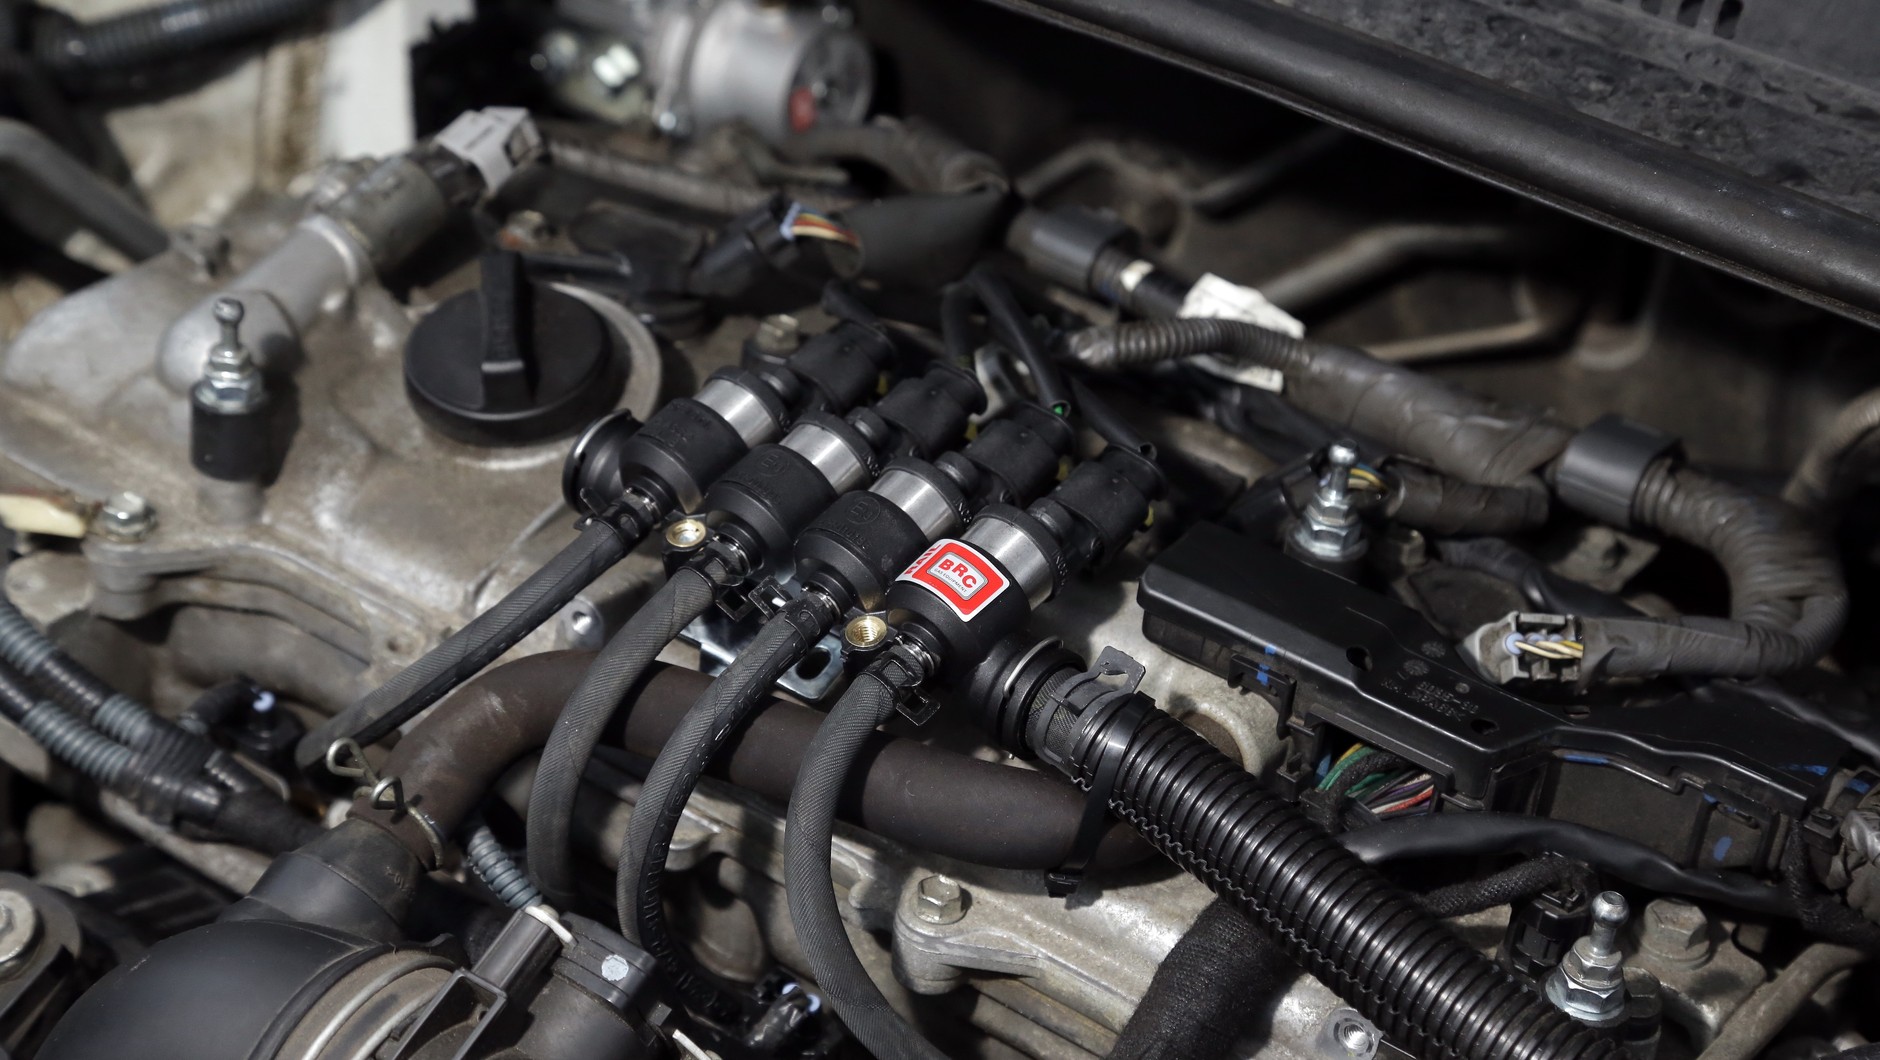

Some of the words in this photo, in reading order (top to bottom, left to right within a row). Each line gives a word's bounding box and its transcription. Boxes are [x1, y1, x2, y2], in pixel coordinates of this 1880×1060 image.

[904, 544, 942, 575] RAIL
[938, 559, 977, 589] BRC
[943, 573, 967, 593] EQUIPMENT
